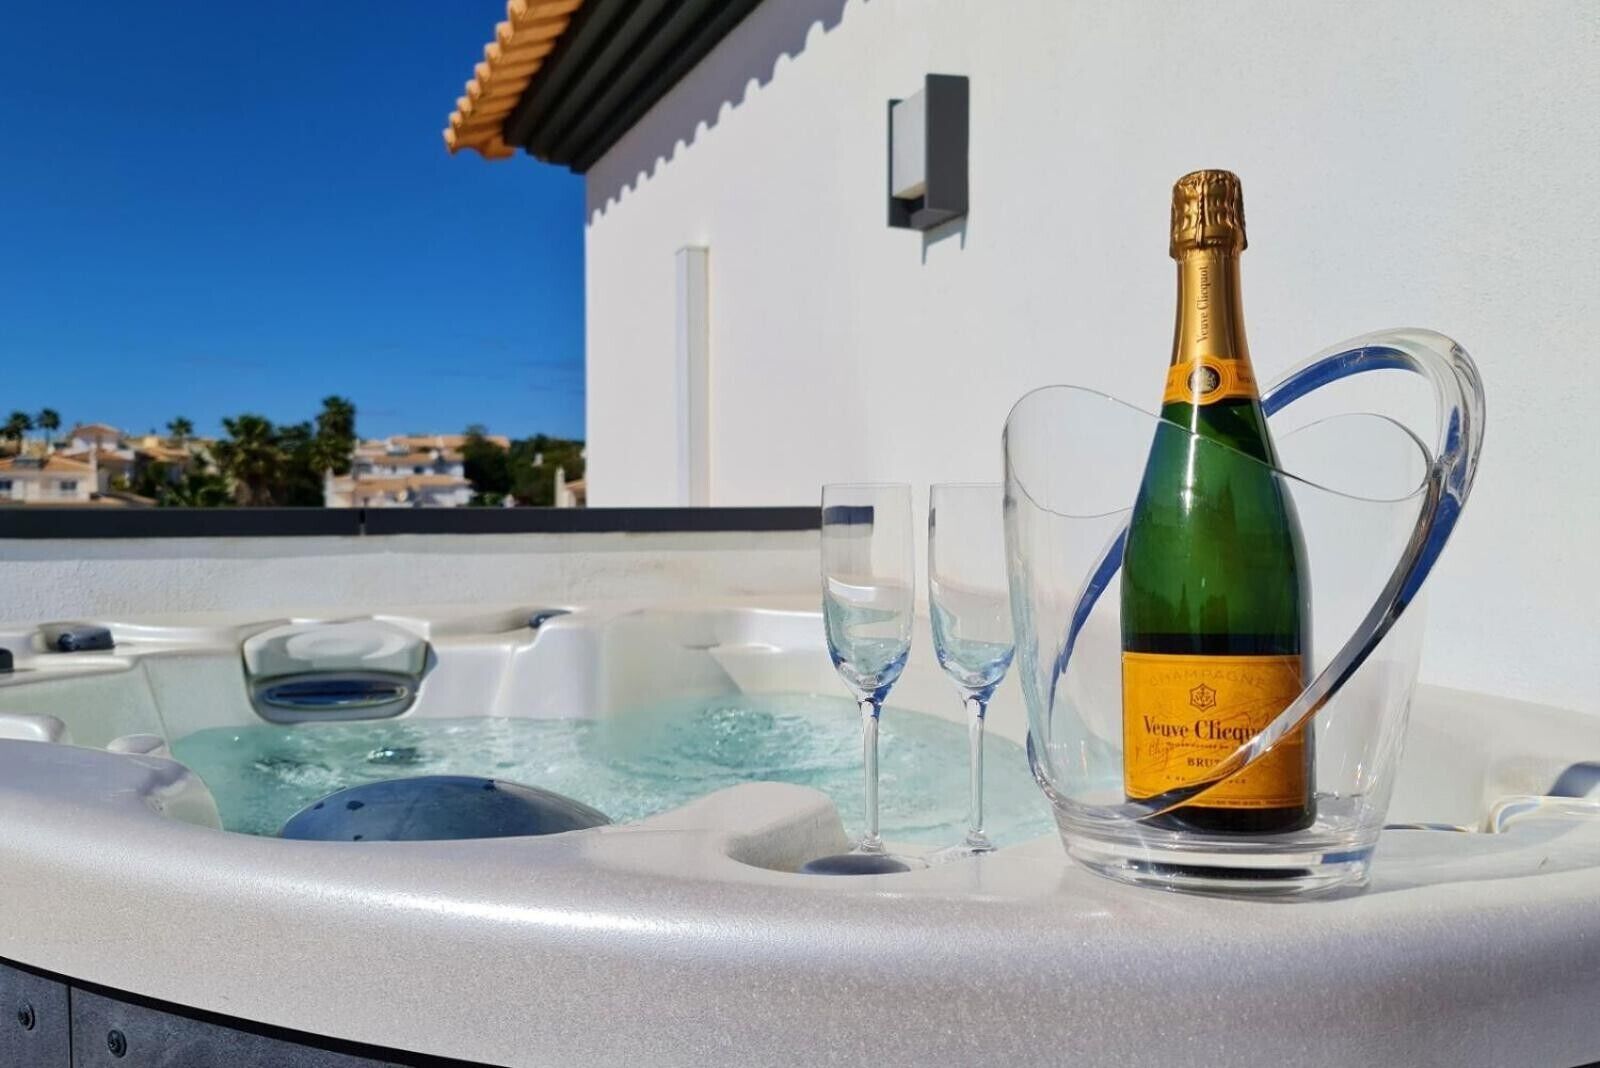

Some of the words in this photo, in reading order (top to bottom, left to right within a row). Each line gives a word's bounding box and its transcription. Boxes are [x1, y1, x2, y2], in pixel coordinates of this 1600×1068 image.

[1197, 265, 1211, 310] Clicquot
[1196, 312, 1209, 343] Veuve
[1150, 669, 1266, 689] CHAMPAGNE
[1143, 715, 1189, 738] Veuve
[1194, 719, 1264, 745] Clicqu
